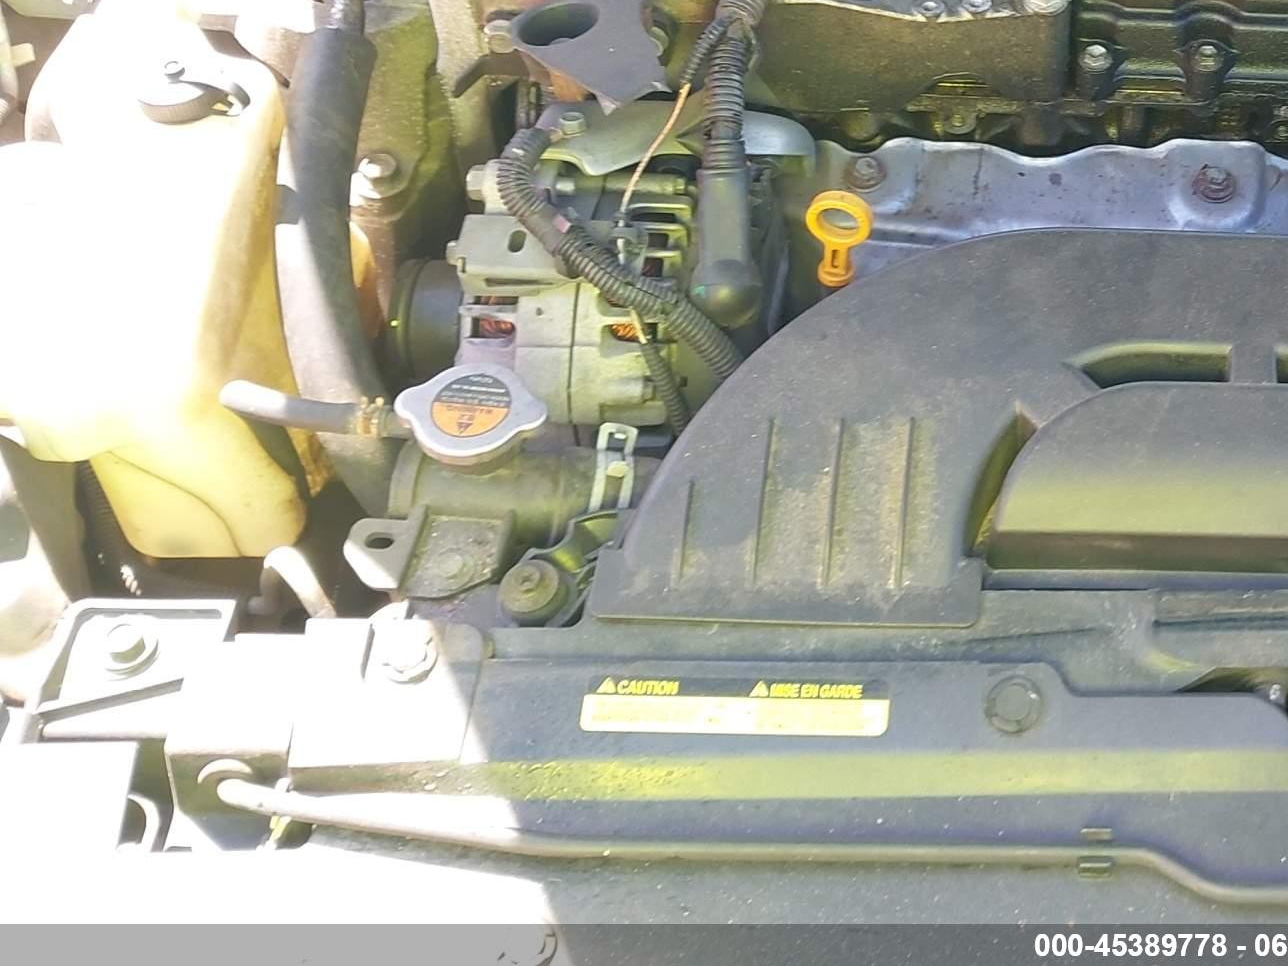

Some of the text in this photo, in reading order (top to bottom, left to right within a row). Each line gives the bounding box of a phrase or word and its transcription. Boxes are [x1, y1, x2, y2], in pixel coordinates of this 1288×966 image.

[616, 679, 680, 695] CAUTION
[769, 682, 864, 699] MISE EN GARDE
